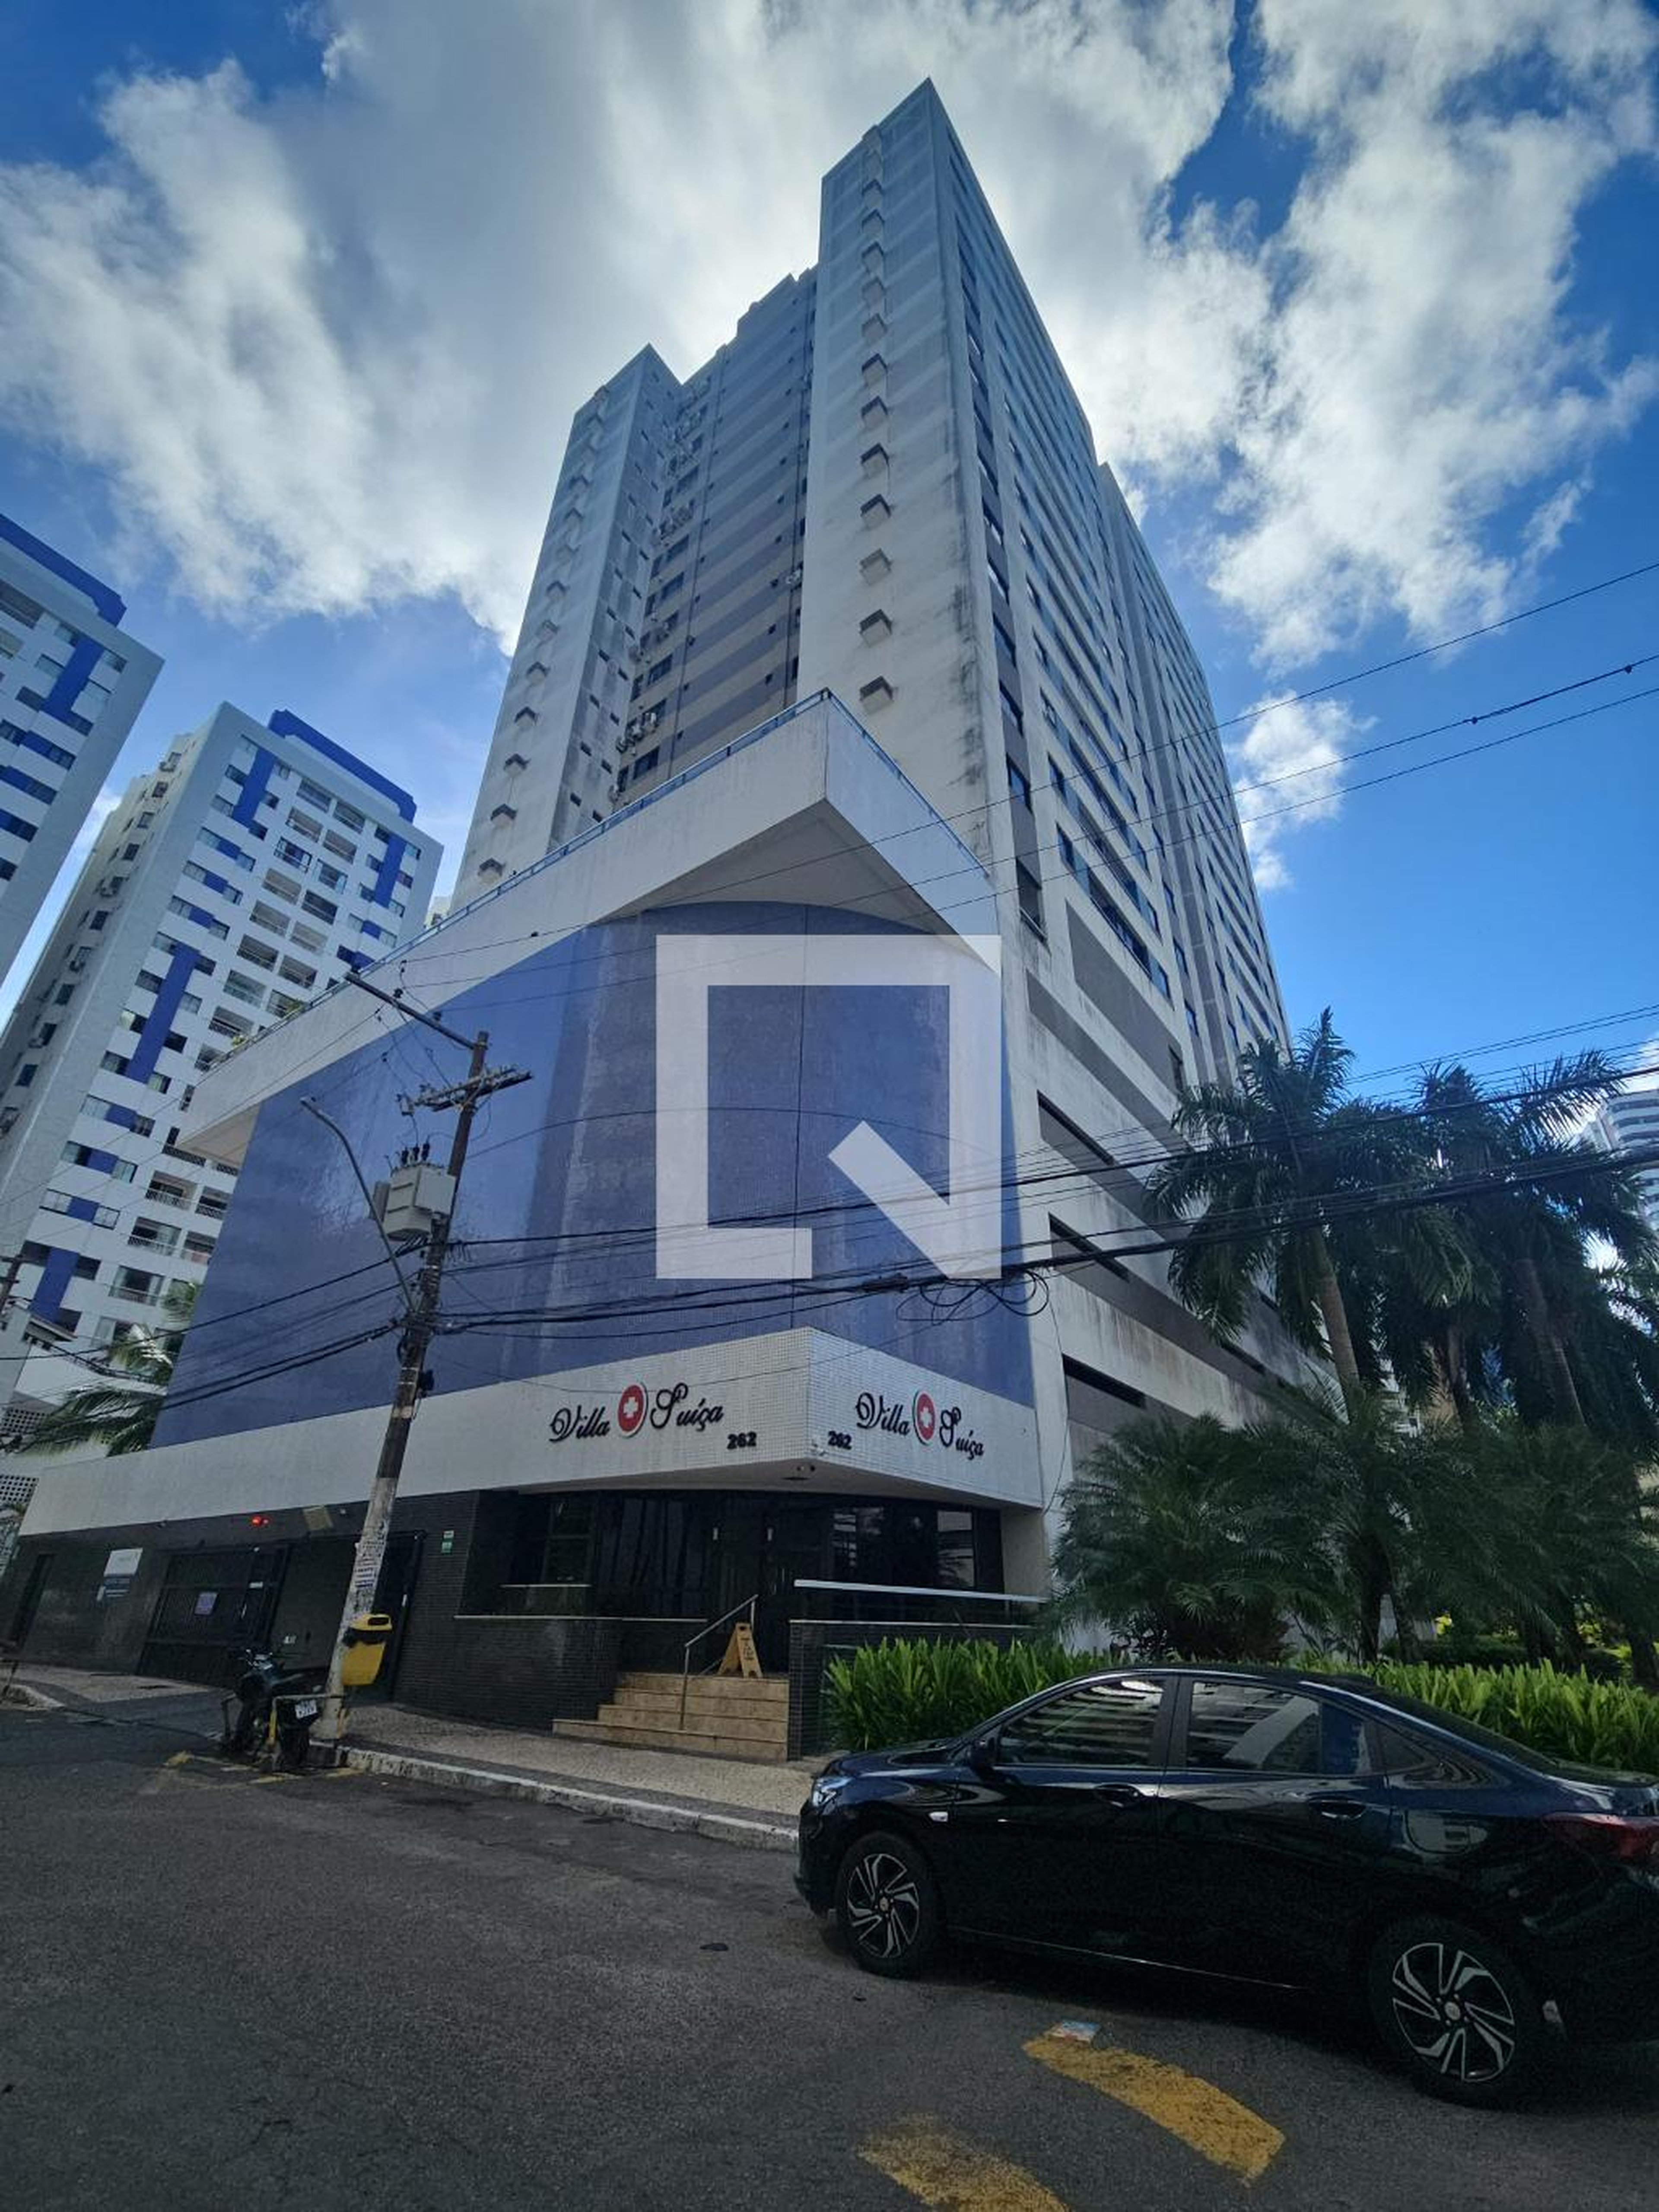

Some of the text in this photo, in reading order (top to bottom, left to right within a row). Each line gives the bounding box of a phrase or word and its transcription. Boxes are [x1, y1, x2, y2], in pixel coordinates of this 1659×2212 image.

[549, 1382, 724, 1443] Villa Suíça
[855, 1392, 984, 1461] Villa Suíça
[727, 1432, 757, 1450] 262
[827, 1430, 852, 1450] 262
